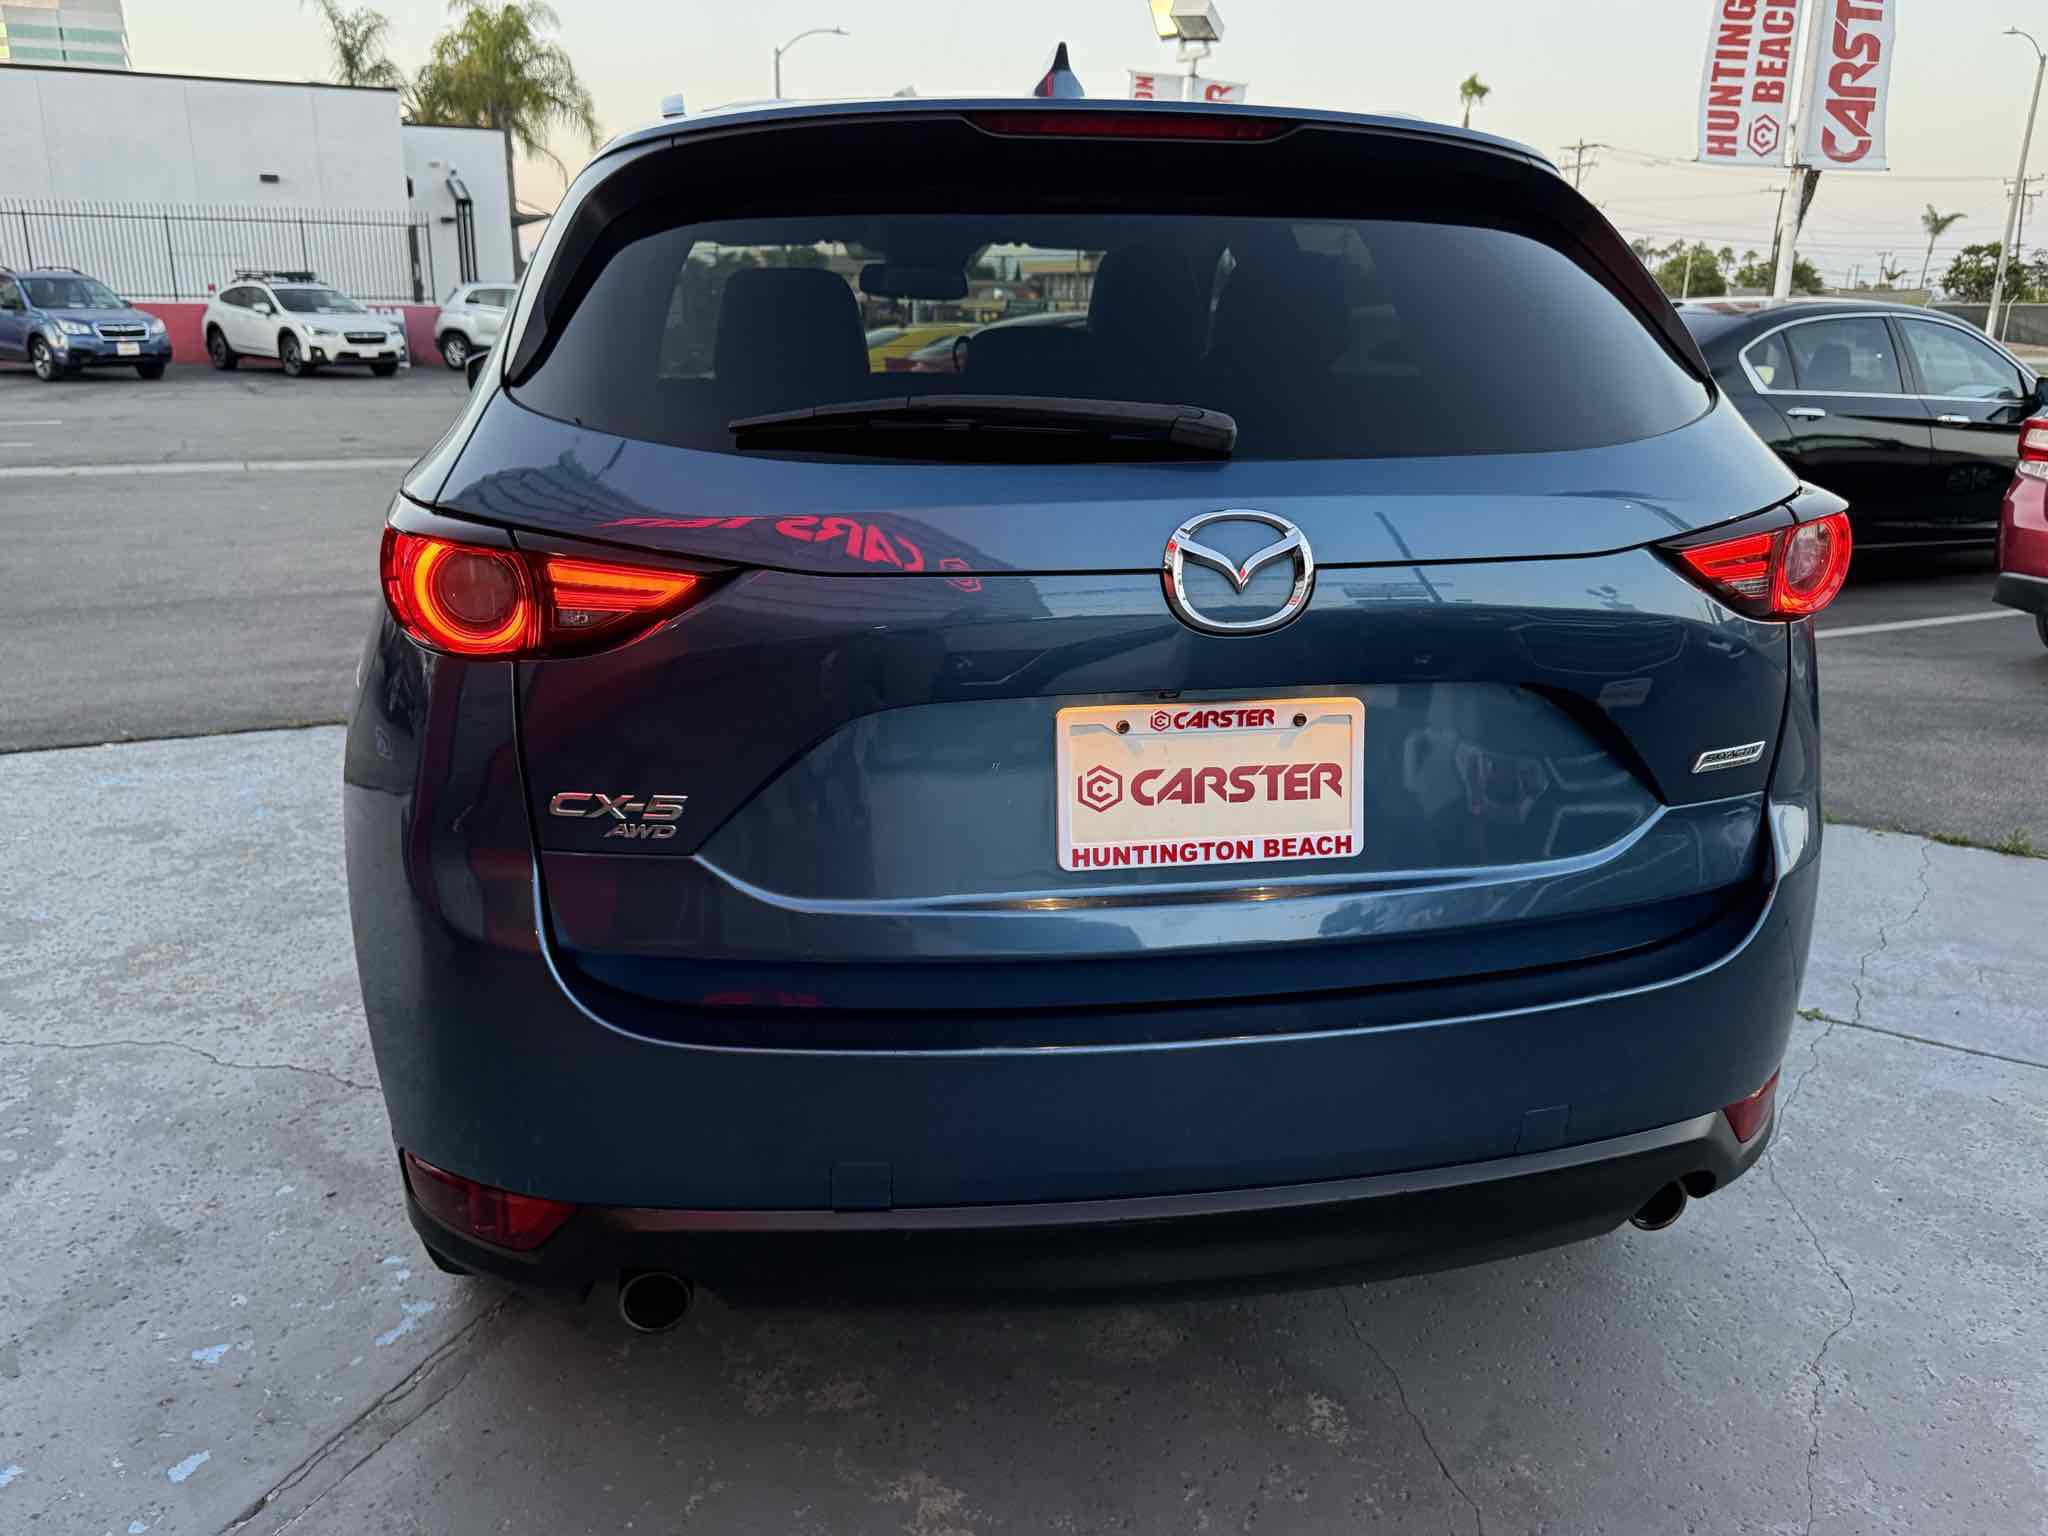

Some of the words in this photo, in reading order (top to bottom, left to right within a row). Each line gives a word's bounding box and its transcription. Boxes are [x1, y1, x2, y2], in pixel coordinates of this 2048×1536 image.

[1173, 708, 1275, 731] CARSTER
[1130, 762, 1344, 806] CARSTER
[549, 791, 689, 821] CX-5
[603, 823, 677, 839] AWD
[1071, 839, 1255, 869] HUNTINGTON
[1262, 834, 1353, 859] BEACH
